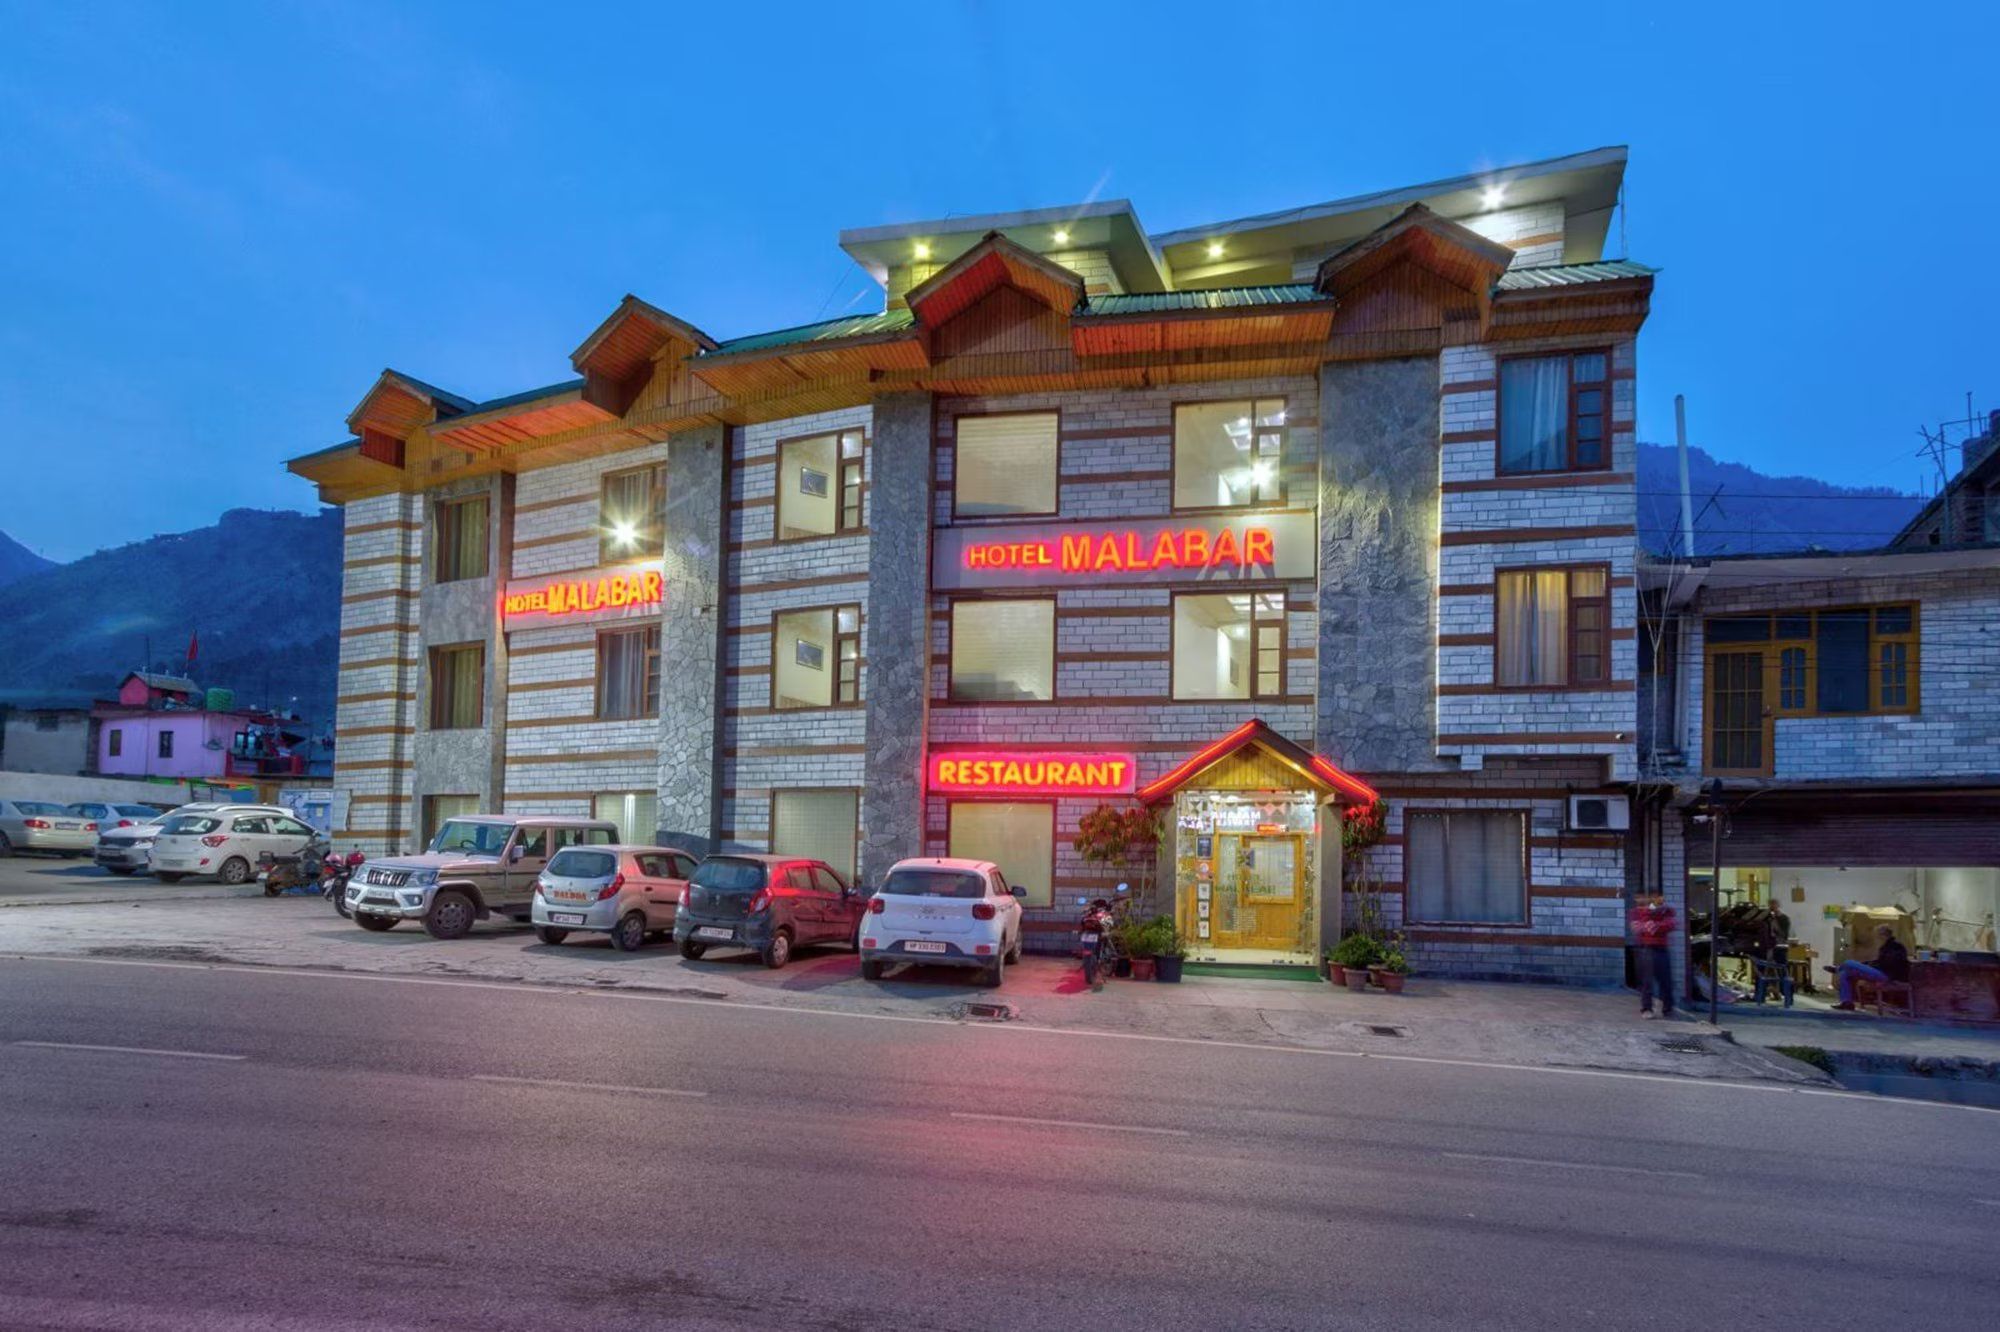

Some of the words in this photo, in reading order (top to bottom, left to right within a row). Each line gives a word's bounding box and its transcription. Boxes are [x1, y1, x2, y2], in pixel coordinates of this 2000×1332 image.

[968, 543, 1053, 568] HOTEL
[1060, 527, 1275, 571] MALABAR
[505, 592, 547, 613] HOTEL
[547, 570, 663, 614] MALABAR
[938, 760, 1126, 786] RESTAURANT
